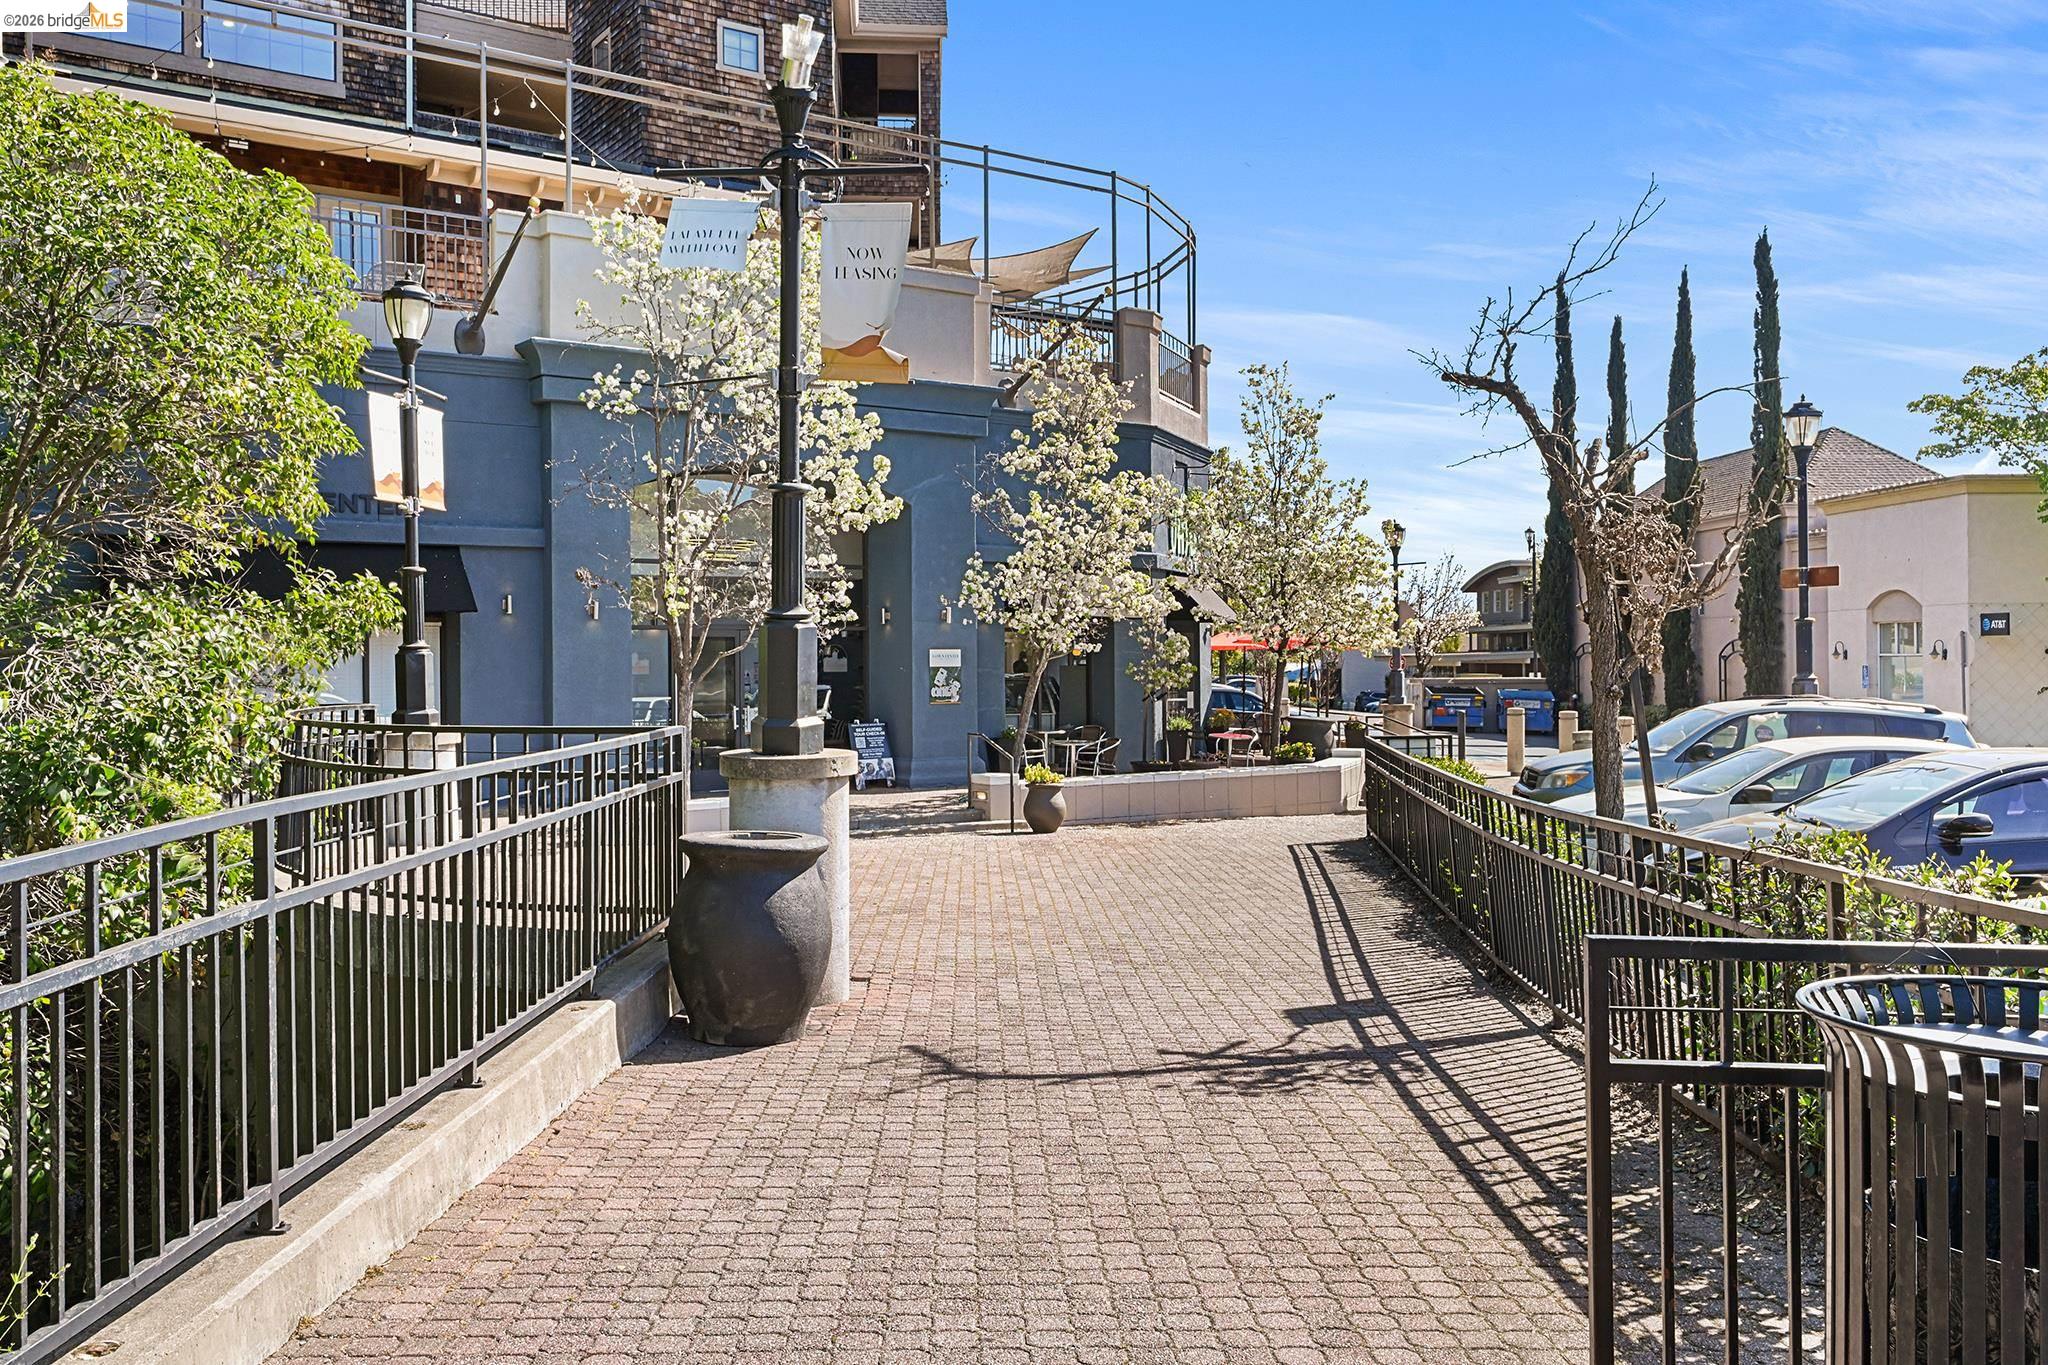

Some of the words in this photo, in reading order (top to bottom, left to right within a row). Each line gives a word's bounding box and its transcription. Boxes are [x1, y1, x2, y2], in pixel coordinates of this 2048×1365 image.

[847, 247, 884, 260] NOW
[835, 266, 897, 280] LEASING
[1991, 619, 2007, 629] AT&T
